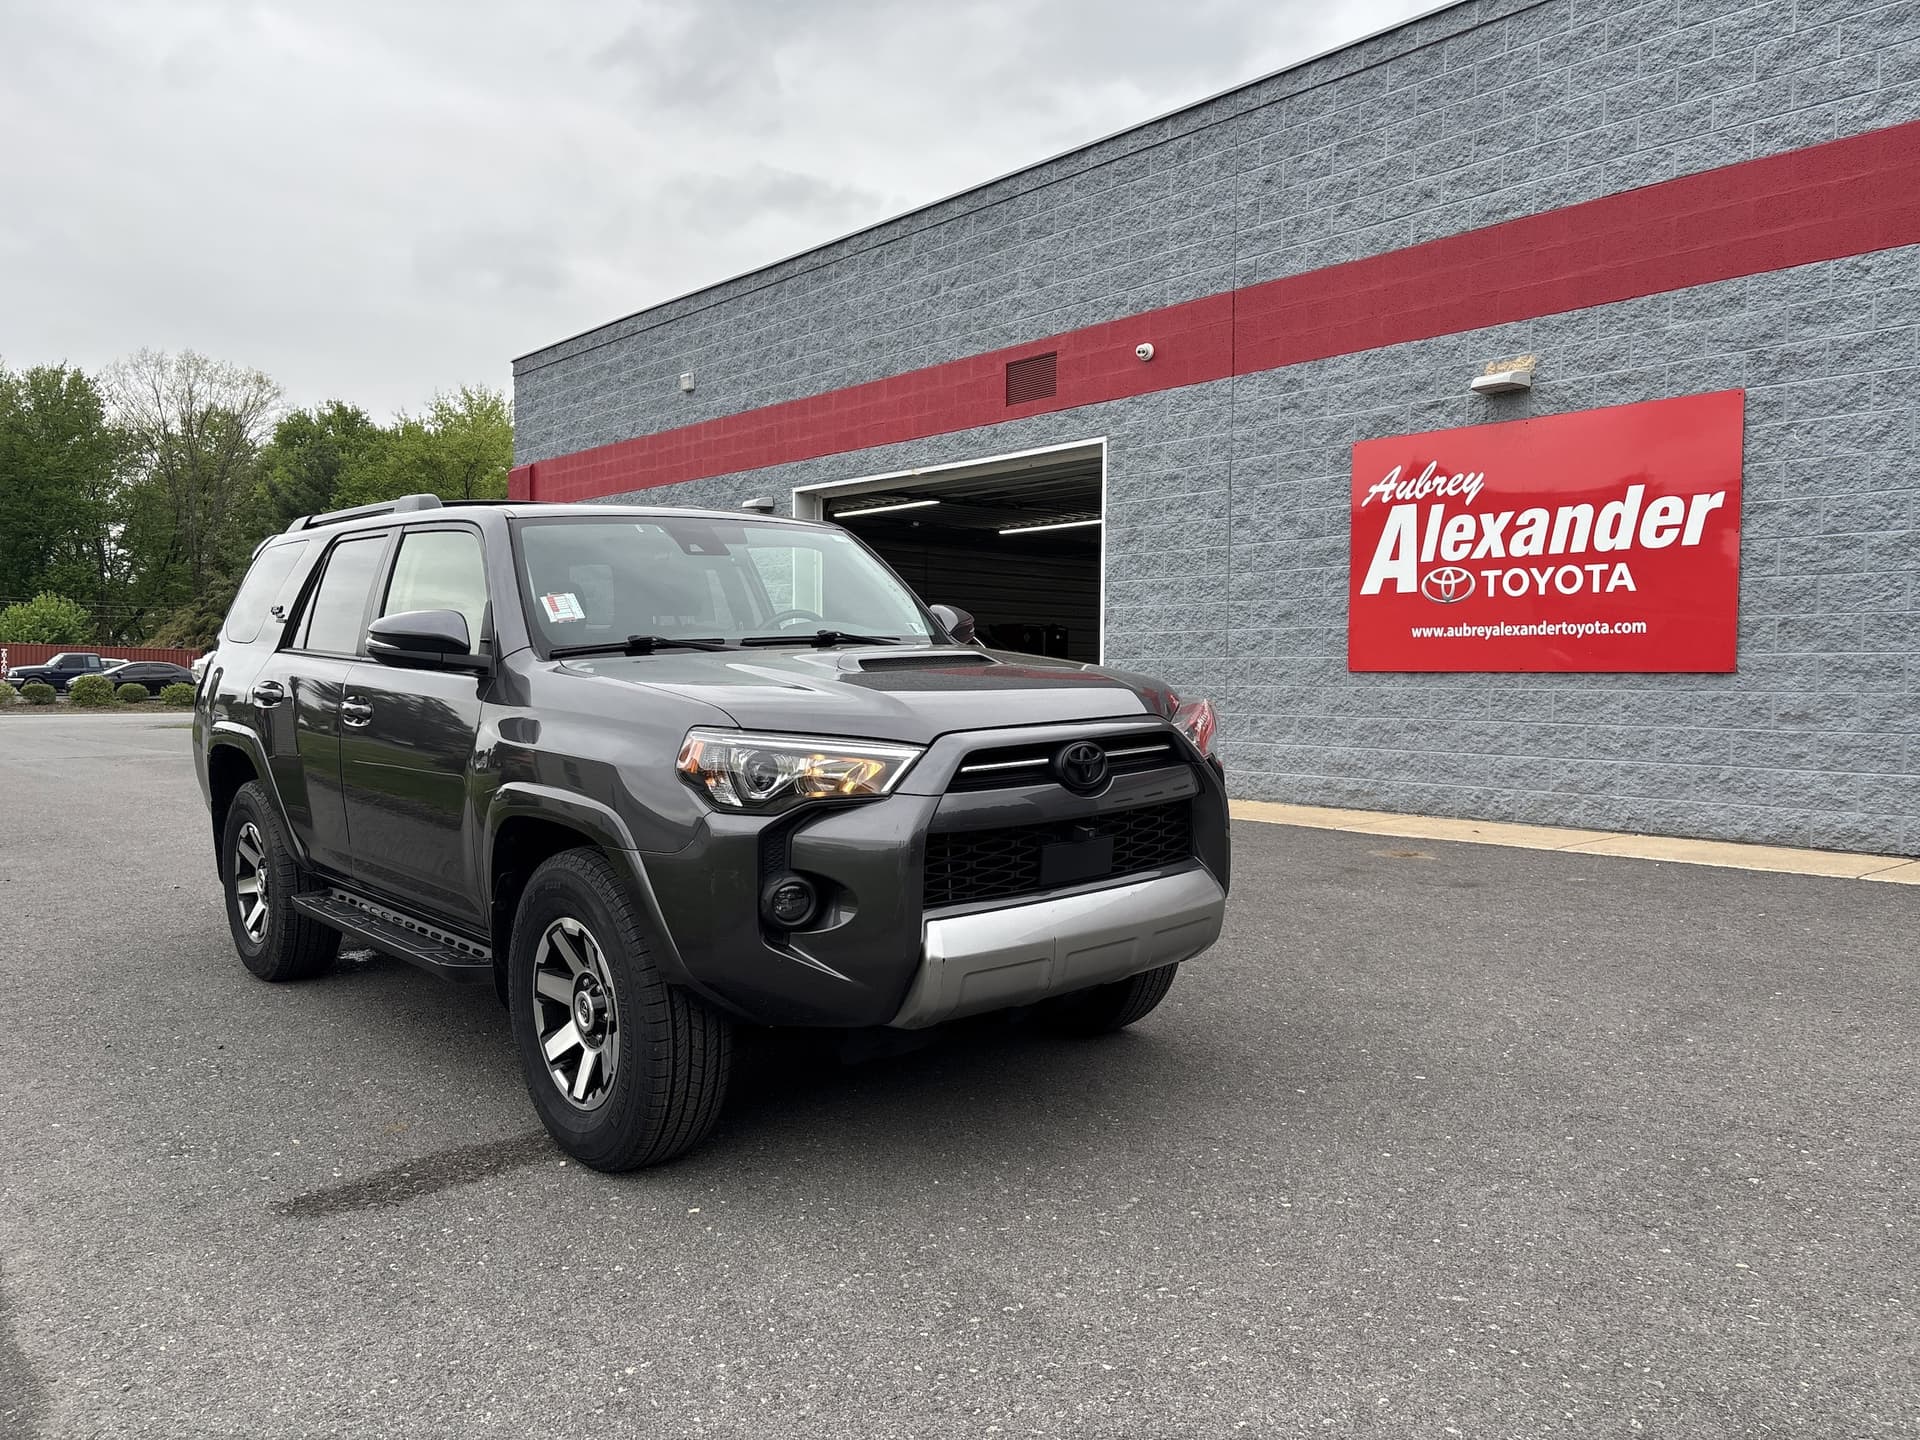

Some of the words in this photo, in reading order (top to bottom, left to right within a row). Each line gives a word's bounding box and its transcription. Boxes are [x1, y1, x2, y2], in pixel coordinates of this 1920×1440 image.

[1361, 460, 1485, 508] Aubrey
[1360, 484, 1726, 595] Alexander
[1481, 563, 1637, 598] TOYOTA
[1411, 620, 1647, 640] www.aubreyalexandertoyota.com
